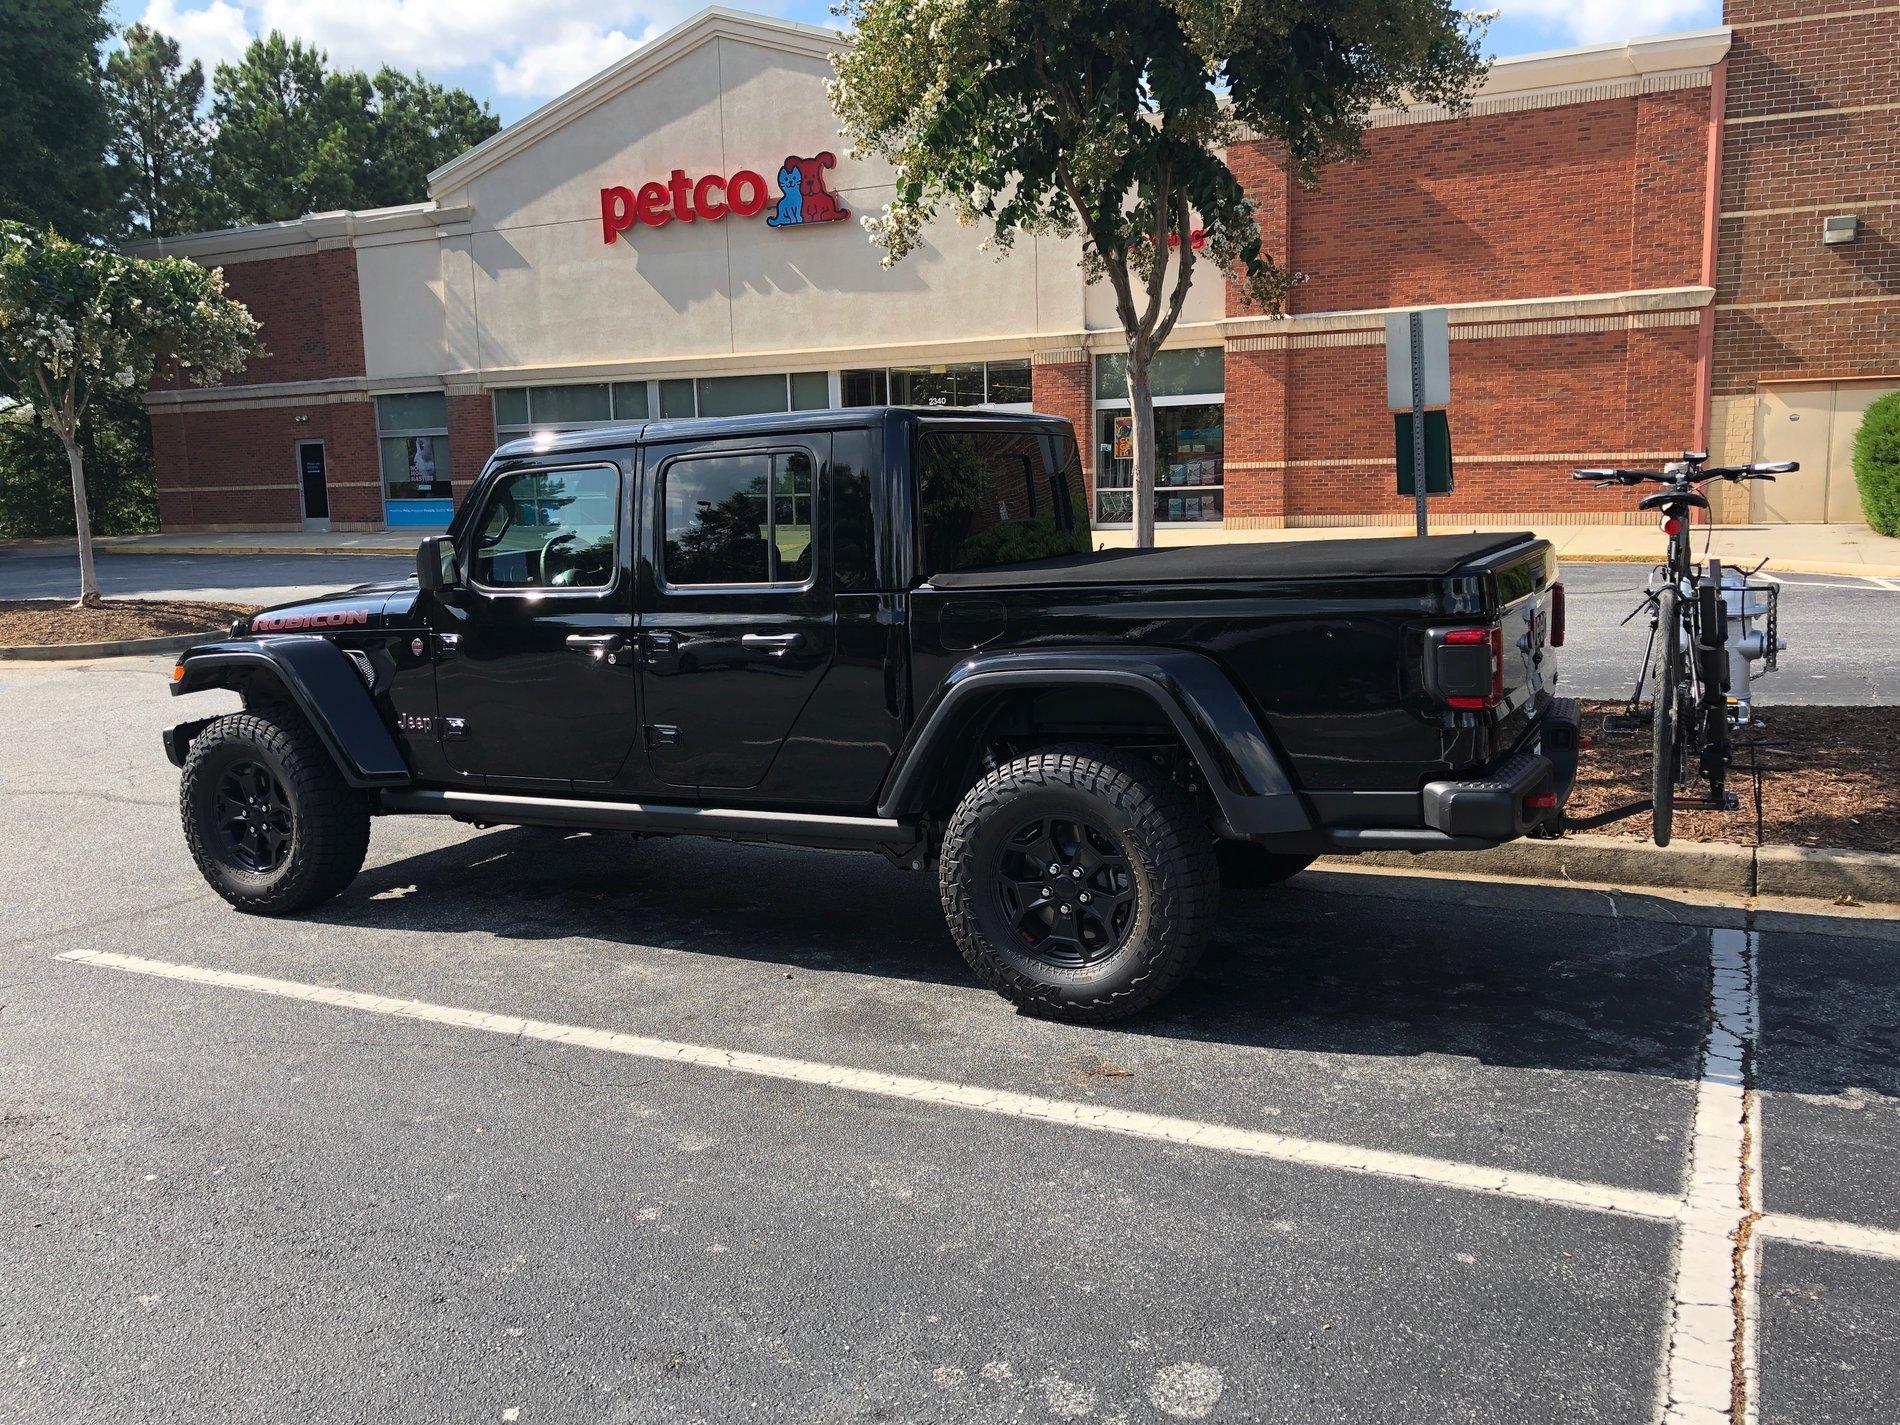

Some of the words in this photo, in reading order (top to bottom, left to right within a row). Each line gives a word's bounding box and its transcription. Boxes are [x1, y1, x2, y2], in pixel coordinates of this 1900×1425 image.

[601, 169, 768, 244] petco
[929, 397, 946, 405] 2340
[252, 608, 369, 632] RUBICON
[397, 712, 432, 732] Jeep
